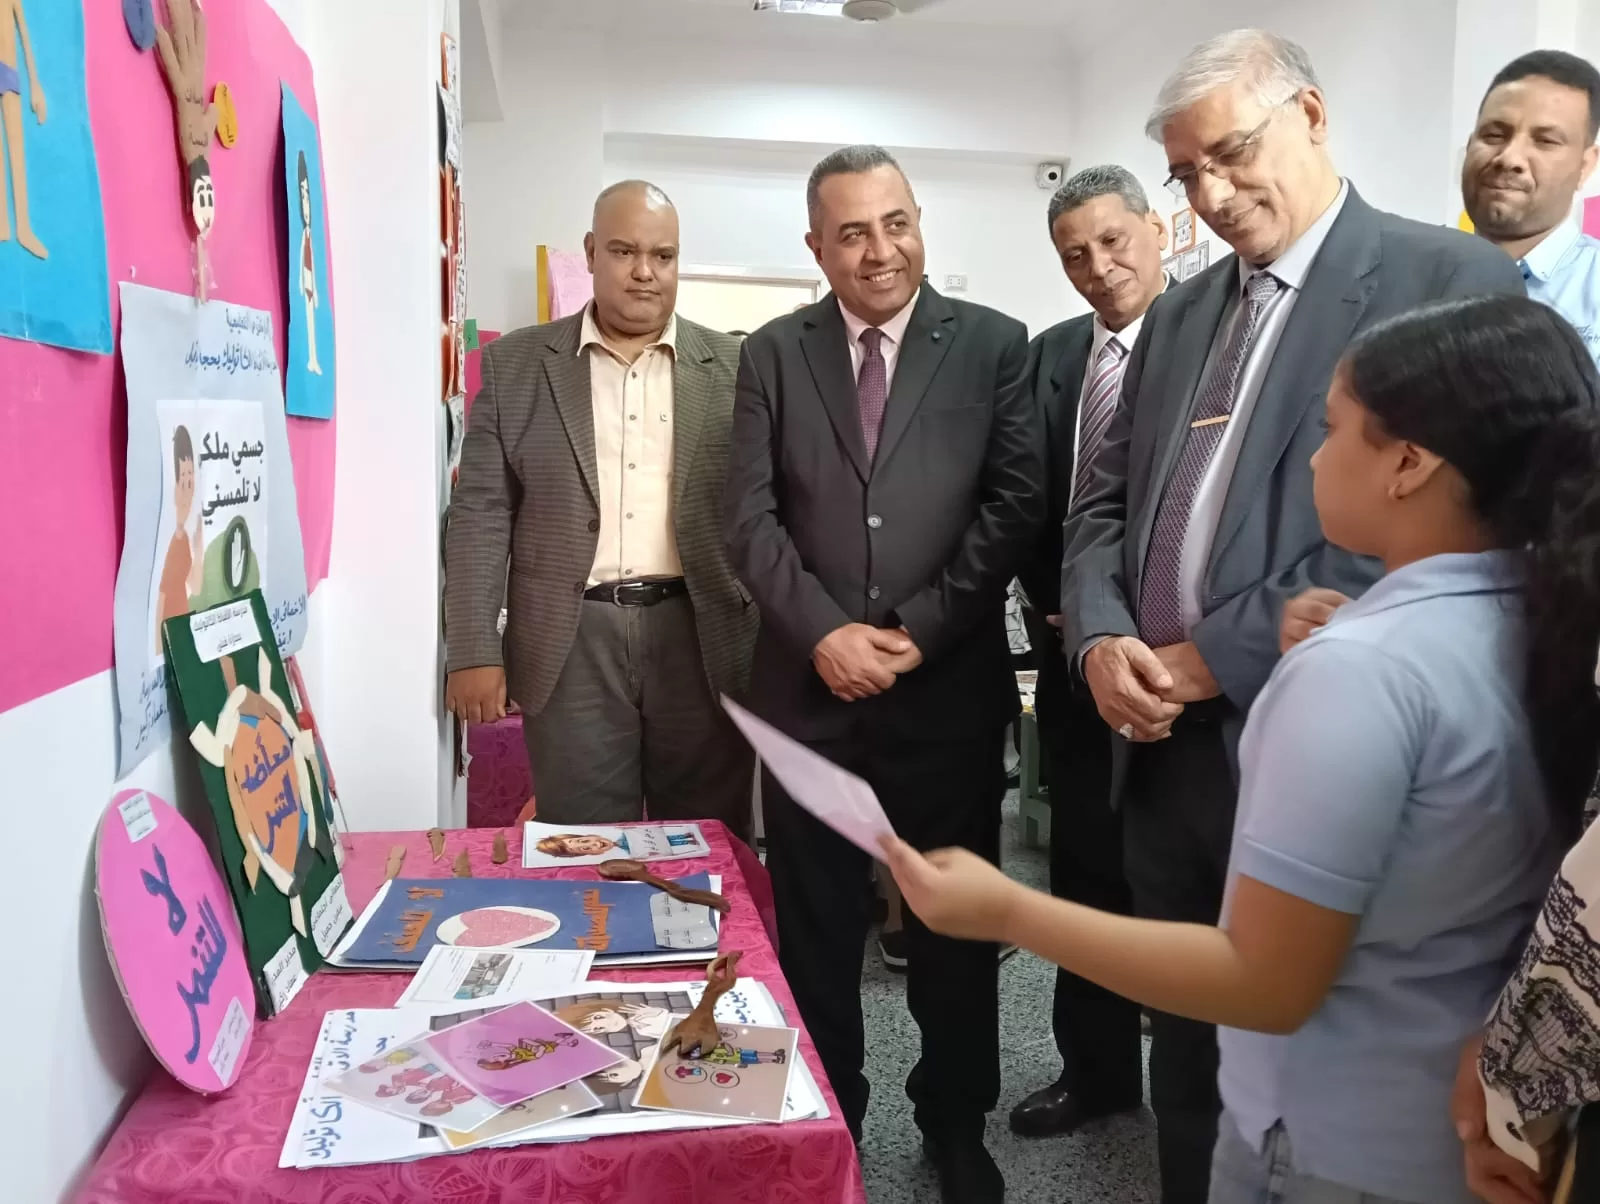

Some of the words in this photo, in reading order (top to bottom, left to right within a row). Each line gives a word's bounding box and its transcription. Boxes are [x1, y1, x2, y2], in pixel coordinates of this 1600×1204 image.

[198, 431, 230, 468] ملك
[231, 439, 264, 474] جسمي
[201, 477, 250, 525] تلمسني
[253, 475, 262, 502] لا
[140, 842, 188, 937] لا
[330, 1011, 357, 1046] مدرسة
